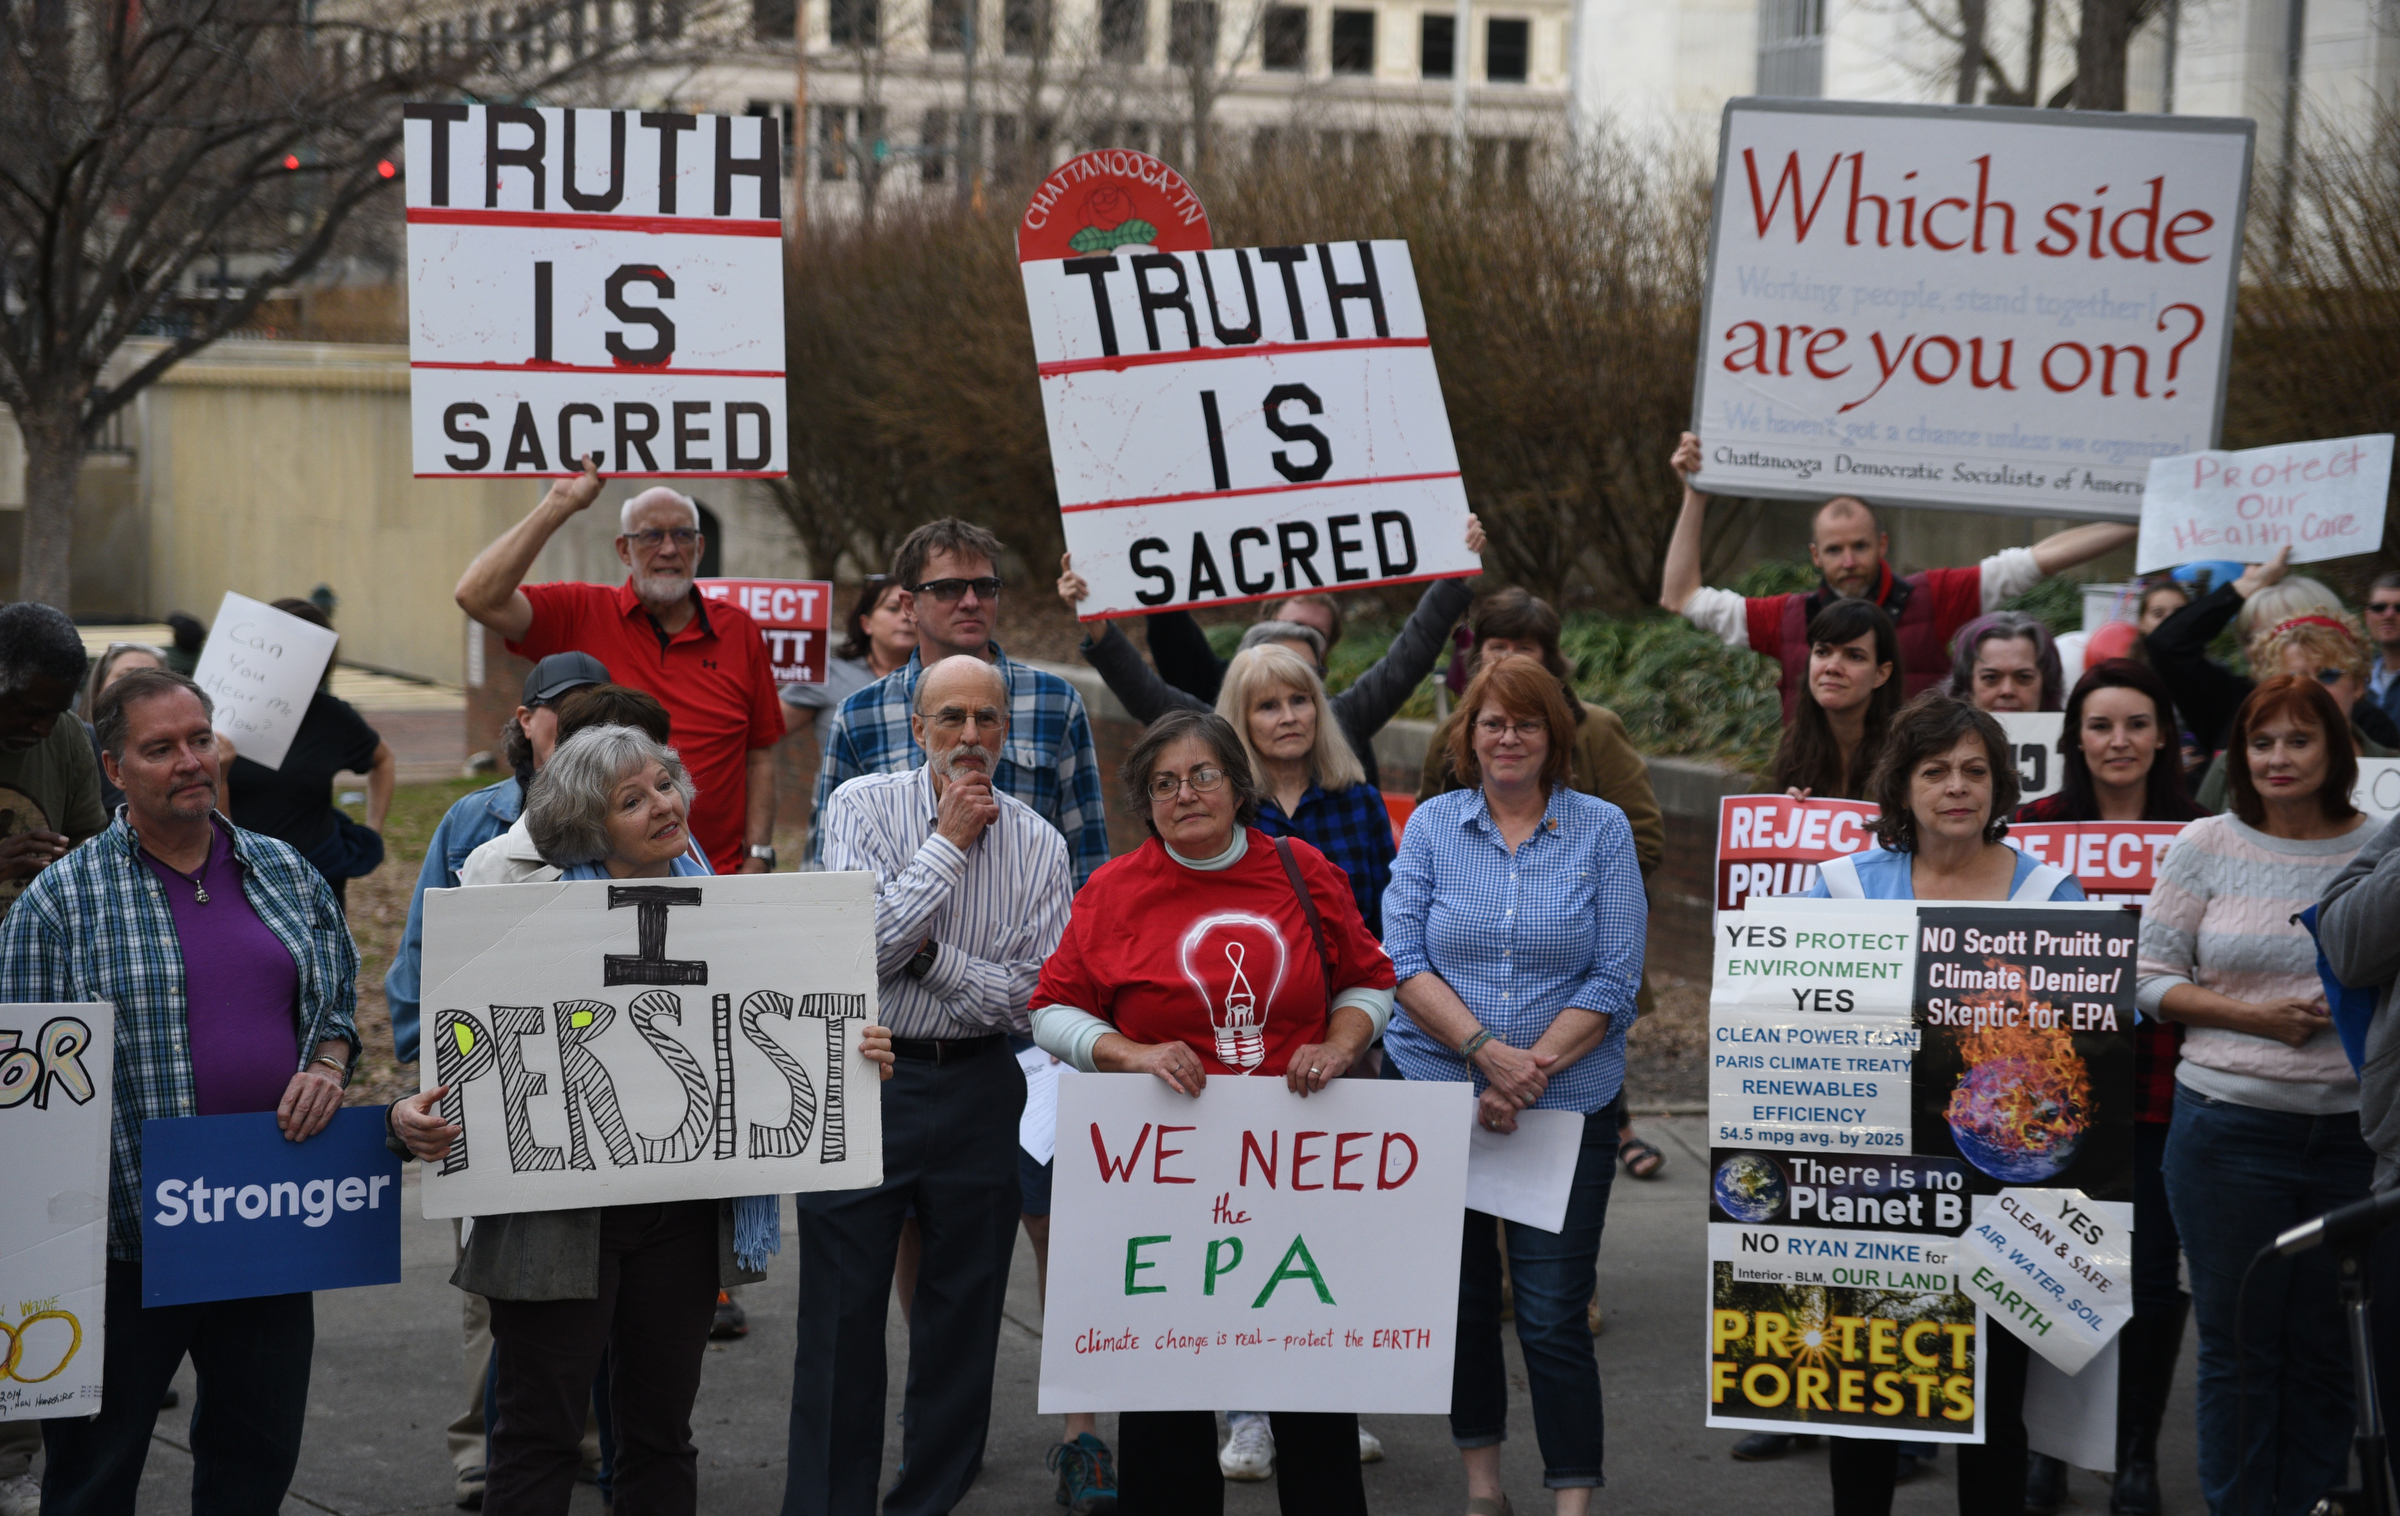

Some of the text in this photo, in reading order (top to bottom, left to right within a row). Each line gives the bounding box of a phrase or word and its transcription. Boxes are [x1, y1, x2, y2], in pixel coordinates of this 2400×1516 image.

[403, 102, 782, 218] TRUTH
[1173, 187, 1204, 226] TN
[1742, 147, 2215, 265] Which side
[534, 261, 676, 367] IS
[1063, 240, 1390, 356] TRUTH
[1738, 265, 2157, 327] Working people, stand together!
[1723, 303, 2205, 415] are you on?
[443, 401, 772, 472] SACRED
[1200, 382, 1333, 490] IS
[1724, 401, 1761, 432] We
[1840, 420, 1880, 446] got
[1887, 425, 1899, 441] a
[1906, 414, 1981, 446] chance
[2058, 437, 2086, 451] we
[1714, 446, 2145, 495] Chattanooga Democratic Socialists of Ameri
[2193, 445, 2366, 489] Protect
[2236, 492, 2307, 521] Our
[2173, 512, 2361, 550] Health Care
[1128, 509, 1418, 606] SACRED
[230, 622, 283, 659] Can
[206, 673, 257, 703] Hear
[771, 662, 812, 681] ruitt
[603, 885, 708, 986] I
[1726, 925, 1909, 951] YES PROTECT
[1922, 927, 2134, 957] NO Scott Pruitt or
[1728, 959, 1904, 979] ENVIRONMENT
[1929, 963, 2122, 993] Climate Denier/
[1792, 988, 1855, 1012] YES
[1927, 998, 2118, 1033] Skeptic for EPA
[1716, 1027, 1917, 1046] CLEAN POWER PLAN
[434, 989, 866, 1177] PERSIST
[1715, 1055, 1912, 1072] PARIS CLIMATE TREATY
[1742, 1080, 1878, 1098] RENEWABLES
[1753, 1105, 1867, 1123] EFFICIENCY
[1090, 1122, 1418, 1191] WE NEED
[1720, 1127, 1904, 1147] 54.5 mpg avg. by 2025
[1789, 1158, 1963, 1190] There is no
[154, 1174, 391, 1227] Stronger
[1212, 1192, 1252, 1224] the
[1790, 1186, 1963, 1228] Planet B
[2058, 1199, 2104, 1245] YES
[1741, 1232, 1948, 1264] NO RYAN ZINKE for
[2000, 1196, 2113, 1293] CLEAN & SAFE
[1124, 1233, 1337, 1309] EPA
[1738, 1268, 1783, 1281] Interior
[1795, 1271, 1827, 1285] BLM,
[1832, 1268, 1880, 1287] OUR
[1888, 1271, 1947, 1291] LAND
[1975, 1224, 2105, 1332] AIR, WATER, SOIL
[1971, 1266, 2053, 1337] EARTH
[1075, 1326, 1140, 1354] Climate
[1155, 1328, 1209, 1354] change
[1217, 1330, 1227, 1345] is
[1235, 1329, 1263, 1345] real
[1284, 1328, 1334, 1351] protect
[1344, 1328, 1364, 1348] the
[1372, 1328, 1431, 1349] EARTH
[1712, 1308, 1976, 1370] PRTECT
[1711, 1361, 1975, 1422] FORESTS
